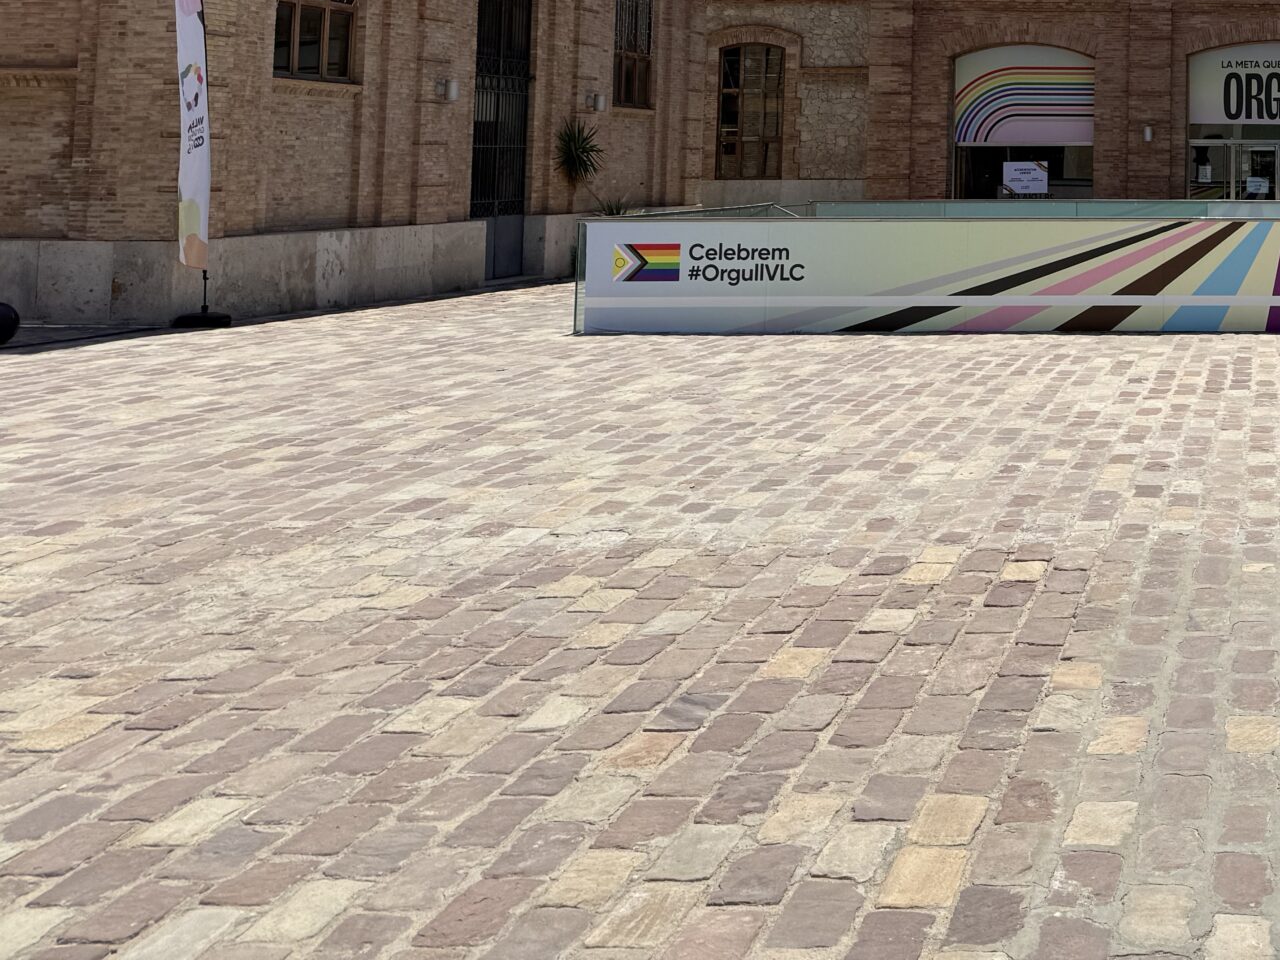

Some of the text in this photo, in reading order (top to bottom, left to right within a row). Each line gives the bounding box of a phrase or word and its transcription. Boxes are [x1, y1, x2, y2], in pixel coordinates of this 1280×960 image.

[1221, 60, 1233, 69] LA
[1235, 60, 1260, 69] META
[689, 243, 790, 261] Celebrem
[688, 263, 805, 286] #OrgullVLC
